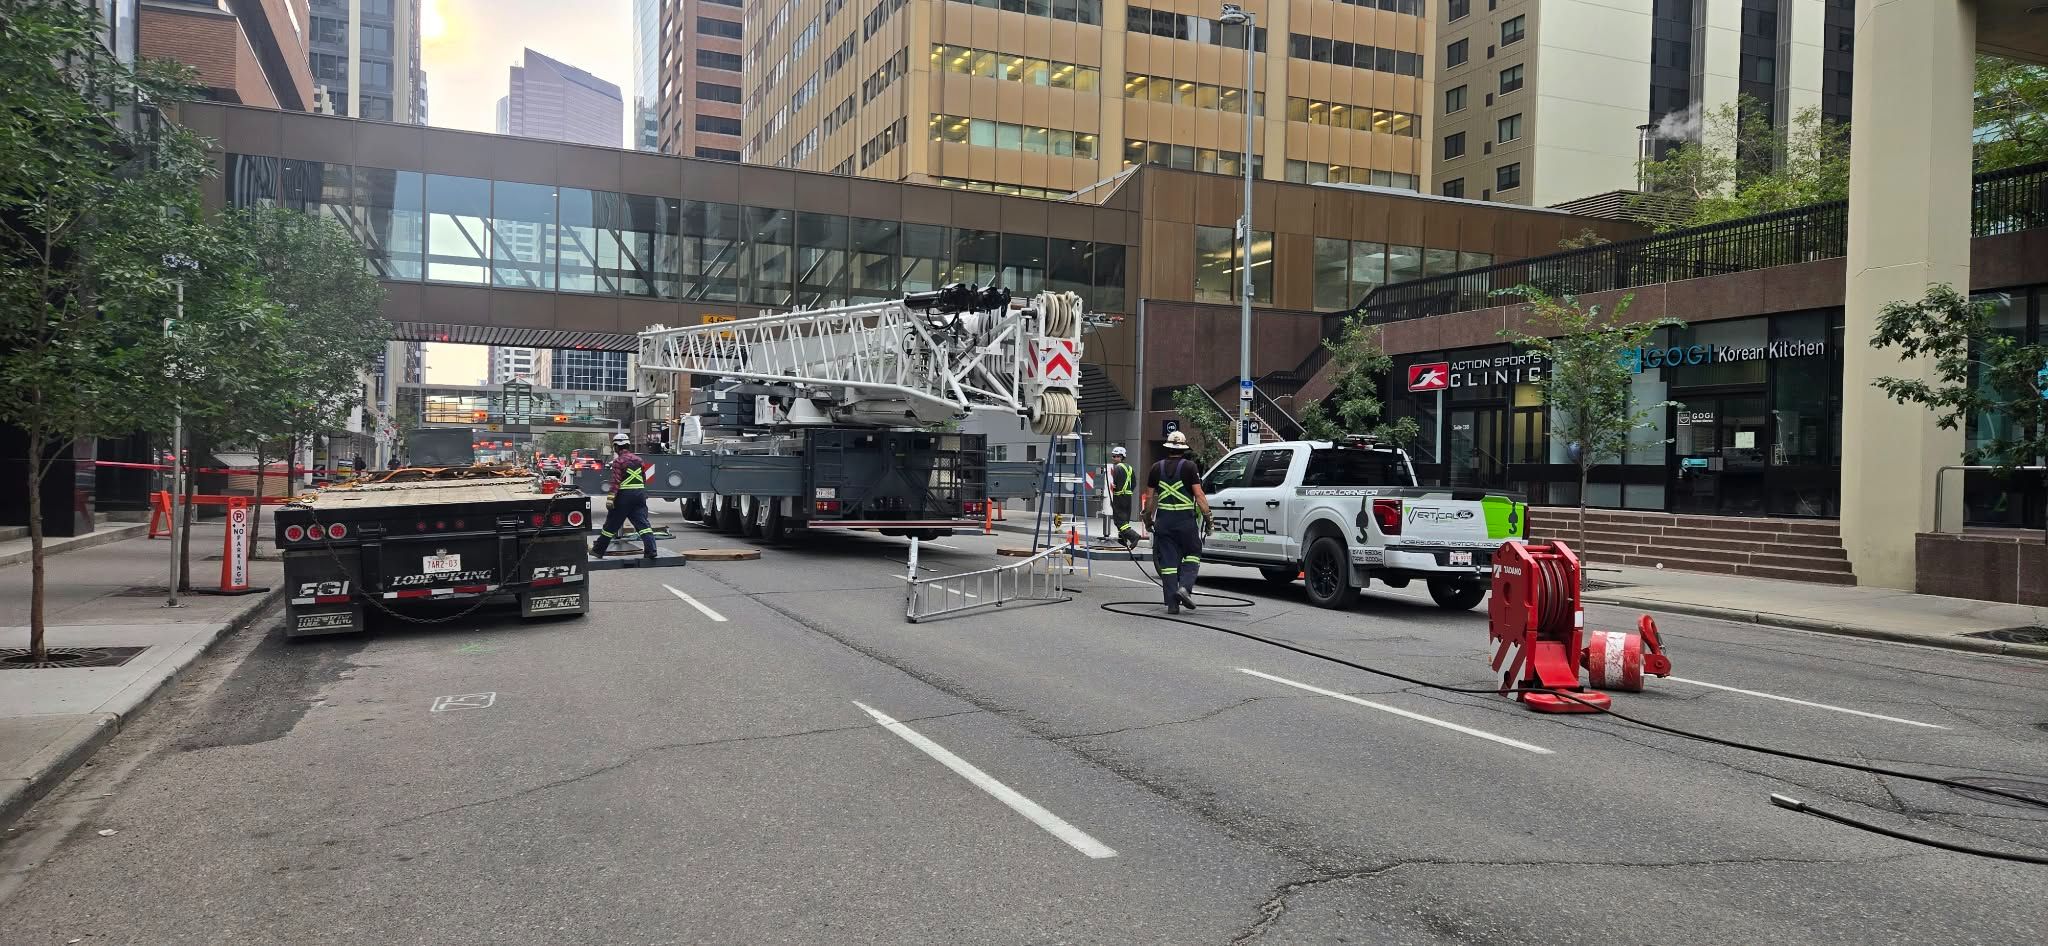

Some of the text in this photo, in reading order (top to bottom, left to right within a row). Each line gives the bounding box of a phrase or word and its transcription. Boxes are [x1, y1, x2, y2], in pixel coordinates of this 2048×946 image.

[1451, 353, 1542, 371] ACTION SPORTS
[1646, 339, 1824, 367] GOGI Korean Kitchen
[1450, 366, 1541, 388] CLINIC
[1692, 411, 1714, 419] GOGI
[1204, 507, 1277, 540] ERTICAL
[1408, 507, 1458, 524] VERTICAL
[391, 570, 492, 586] LODE KING
